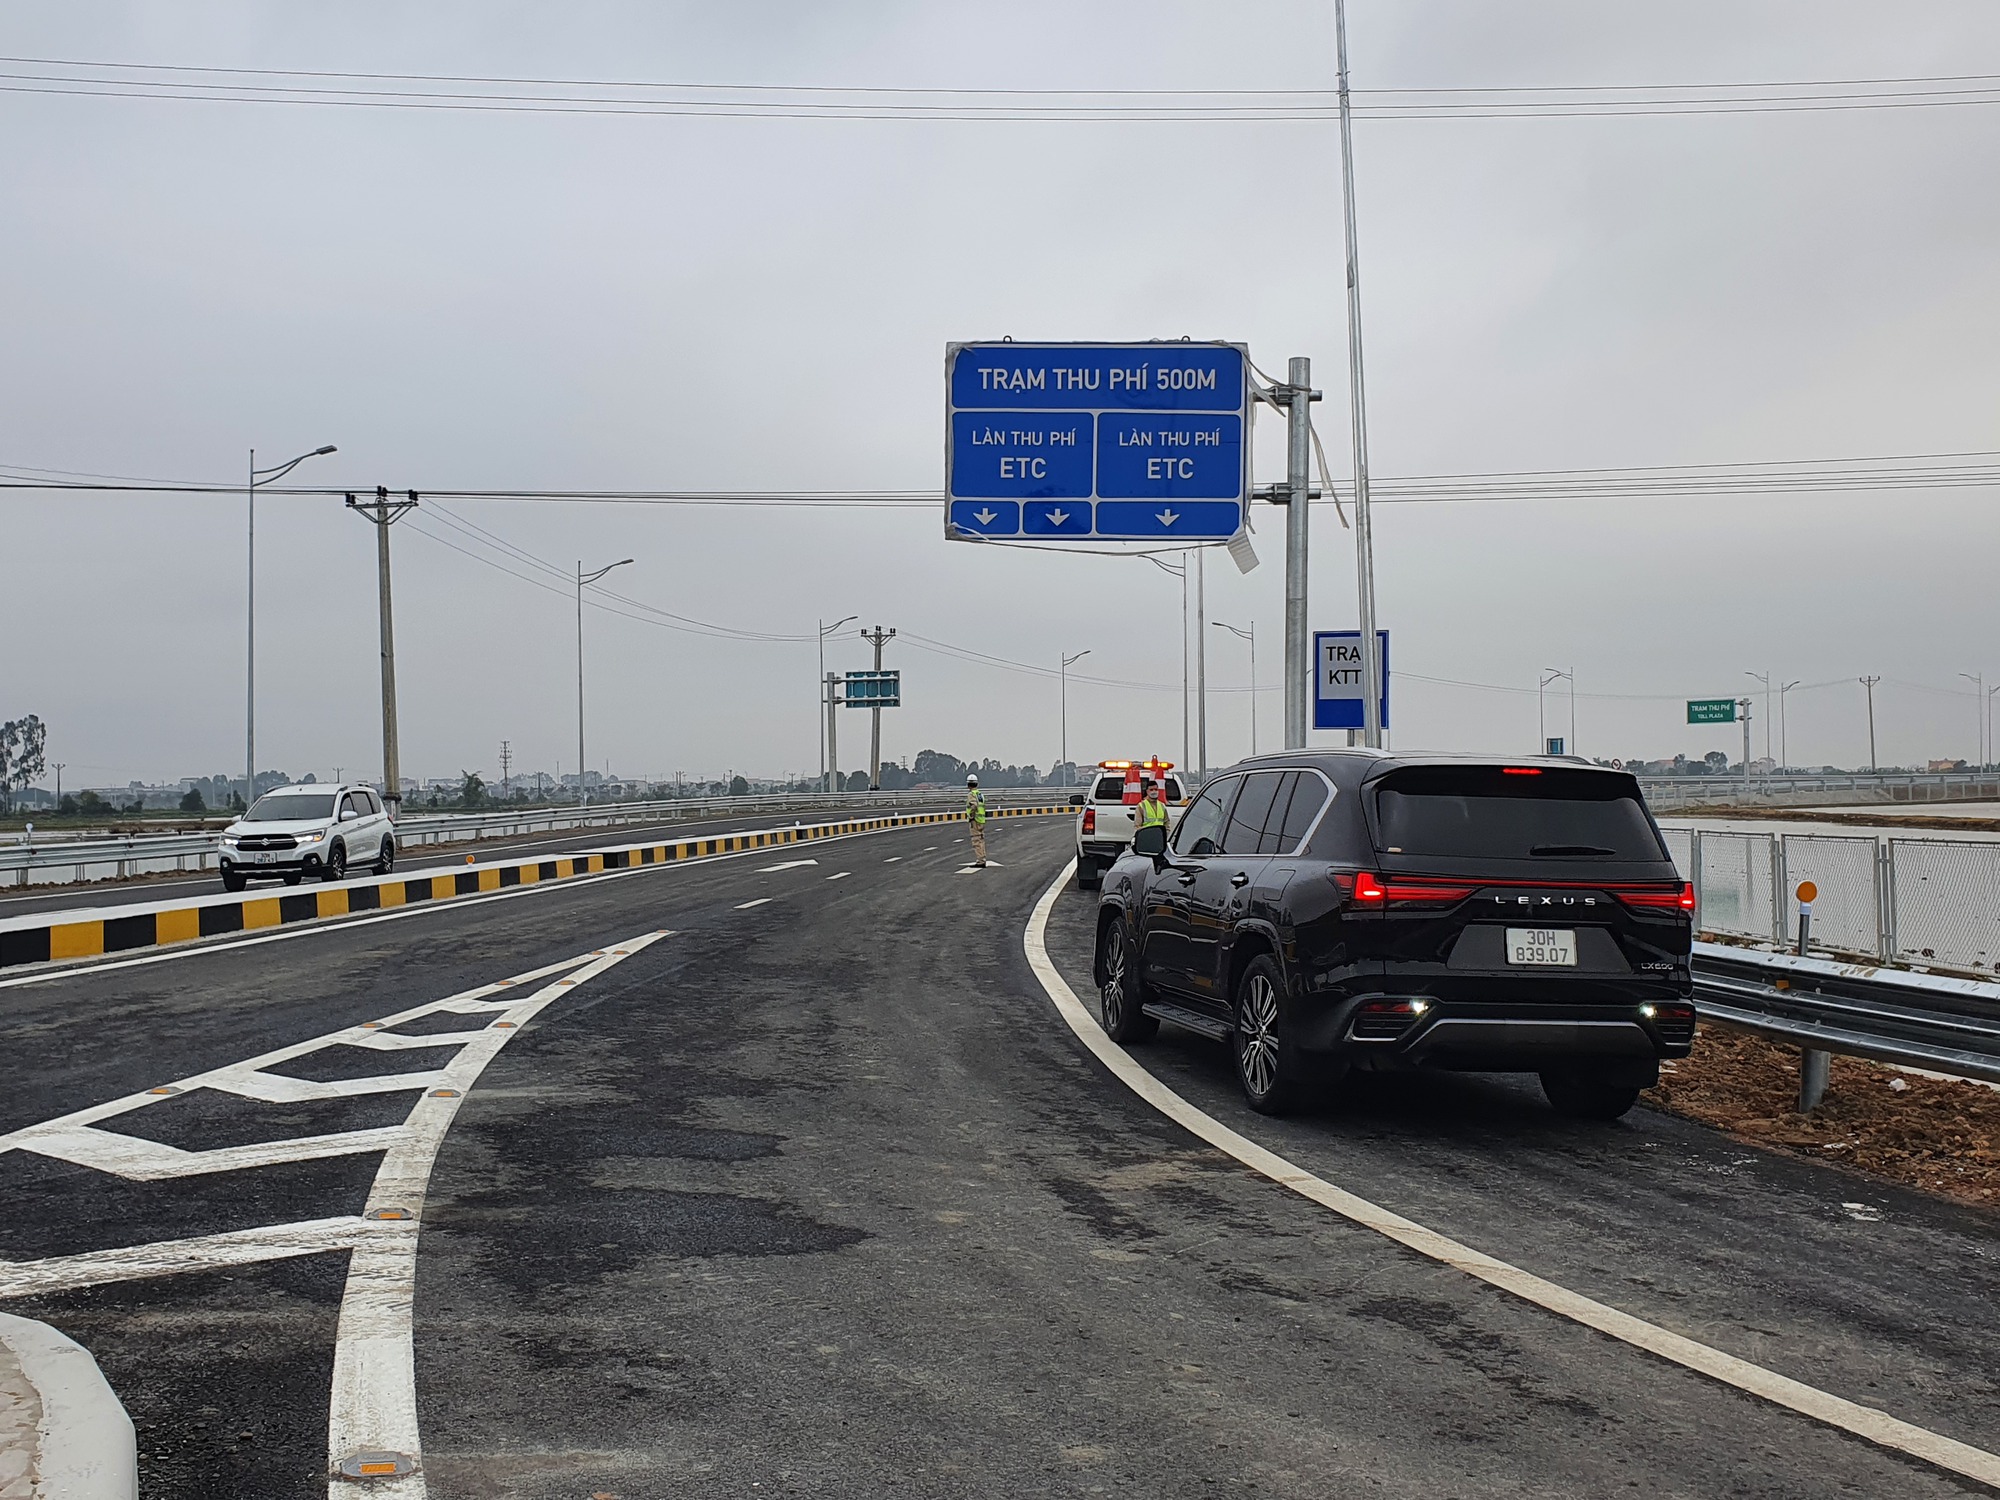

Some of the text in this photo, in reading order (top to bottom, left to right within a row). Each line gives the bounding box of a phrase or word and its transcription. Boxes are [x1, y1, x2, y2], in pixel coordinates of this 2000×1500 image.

[978, 363, 1216, 392] TRẠM THU PHÍ 500M
[972, 427, 1076, 446] LÀN THU PHÍ
[1119, 428, 1220, 446] LÀN THU PHÍ
[1000, 457, 1047, 479] ETC
[1147, 458, 1194, 479] ETC
[1326, 646, 1361, 664] TRẠ
[1495, 896, 1596, 906] LEXUS
[1526, 930, 1556, 946] 30H
[1515, 948, 1568, 963] 839.07
